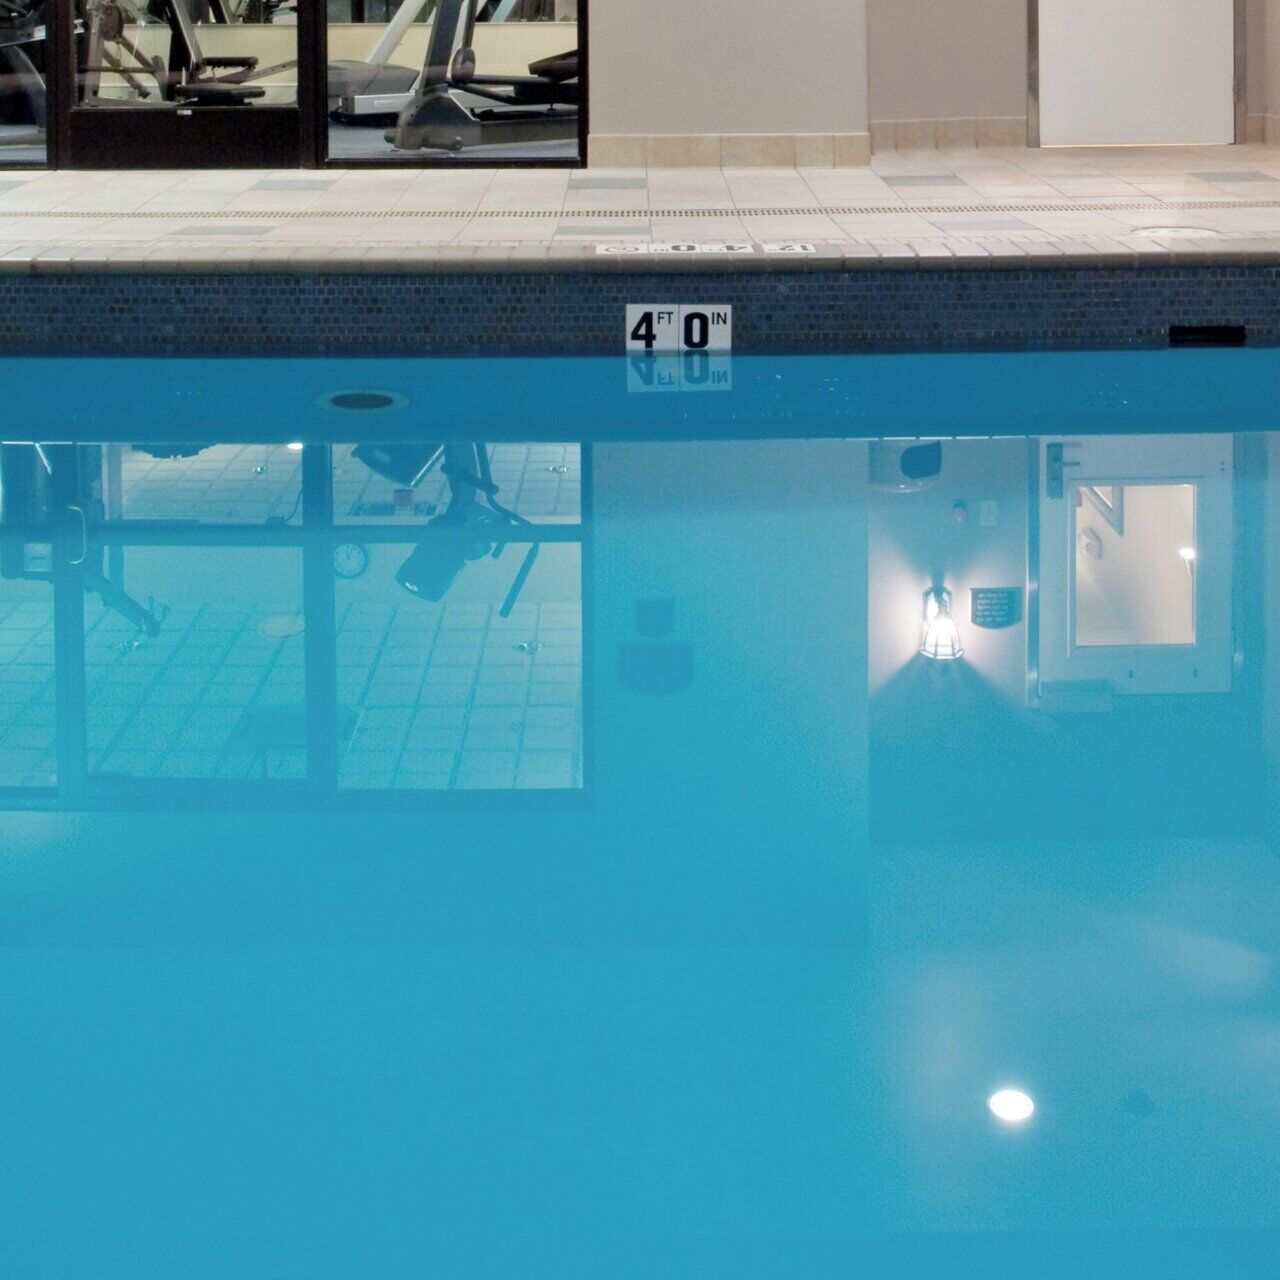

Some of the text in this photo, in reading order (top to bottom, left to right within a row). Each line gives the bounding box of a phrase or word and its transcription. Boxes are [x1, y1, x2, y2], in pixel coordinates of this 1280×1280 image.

[630, 311, 727, 348] 4 FT 0 IN
